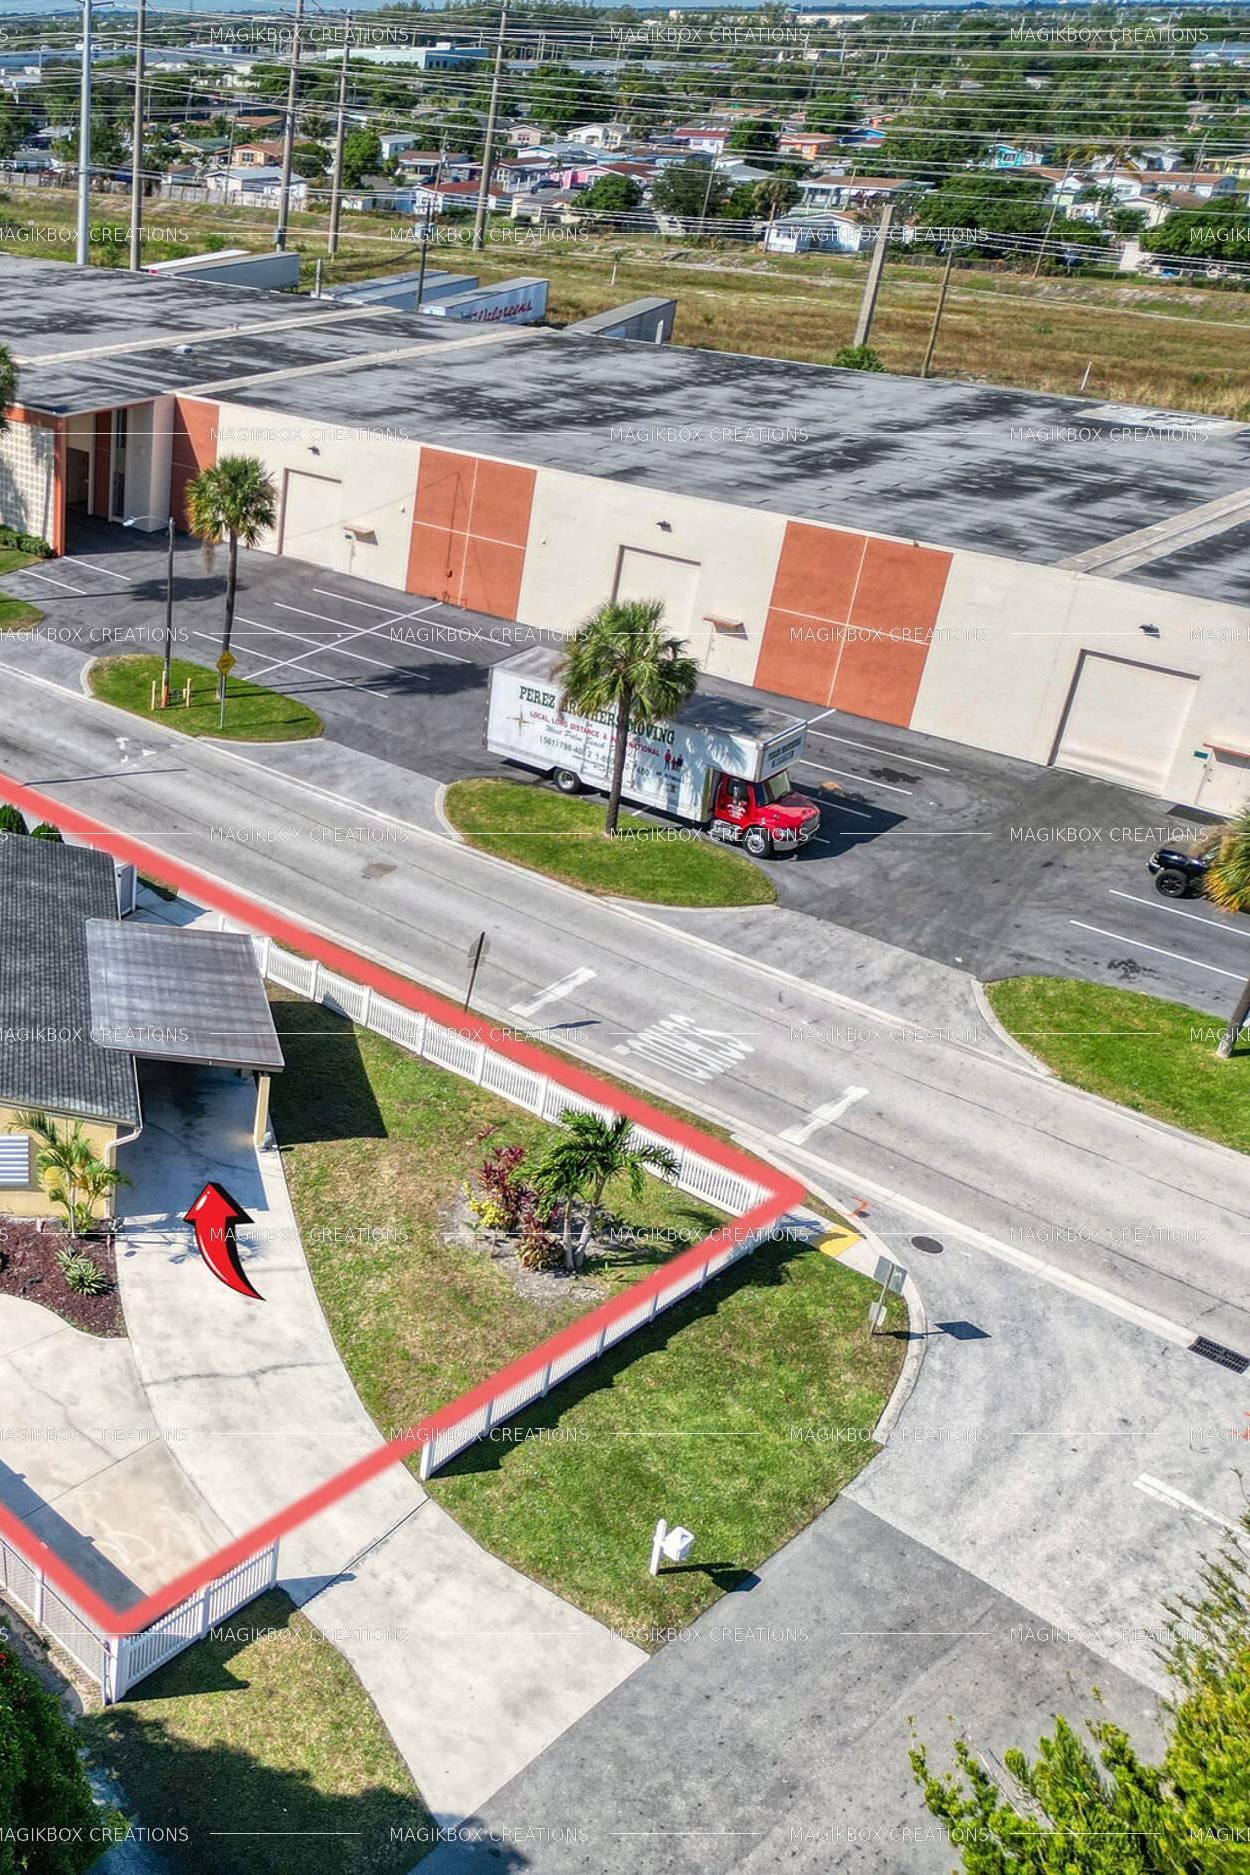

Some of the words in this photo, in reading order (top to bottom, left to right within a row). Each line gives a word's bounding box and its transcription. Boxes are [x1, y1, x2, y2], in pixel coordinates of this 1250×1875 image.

[518, 685, 556, 709] PEREZ
[552, 718, 568, 728] LONG
[570, 723, 600, 738] DISTANCE
[612, 1013, 755, 1085] SCHOOL
